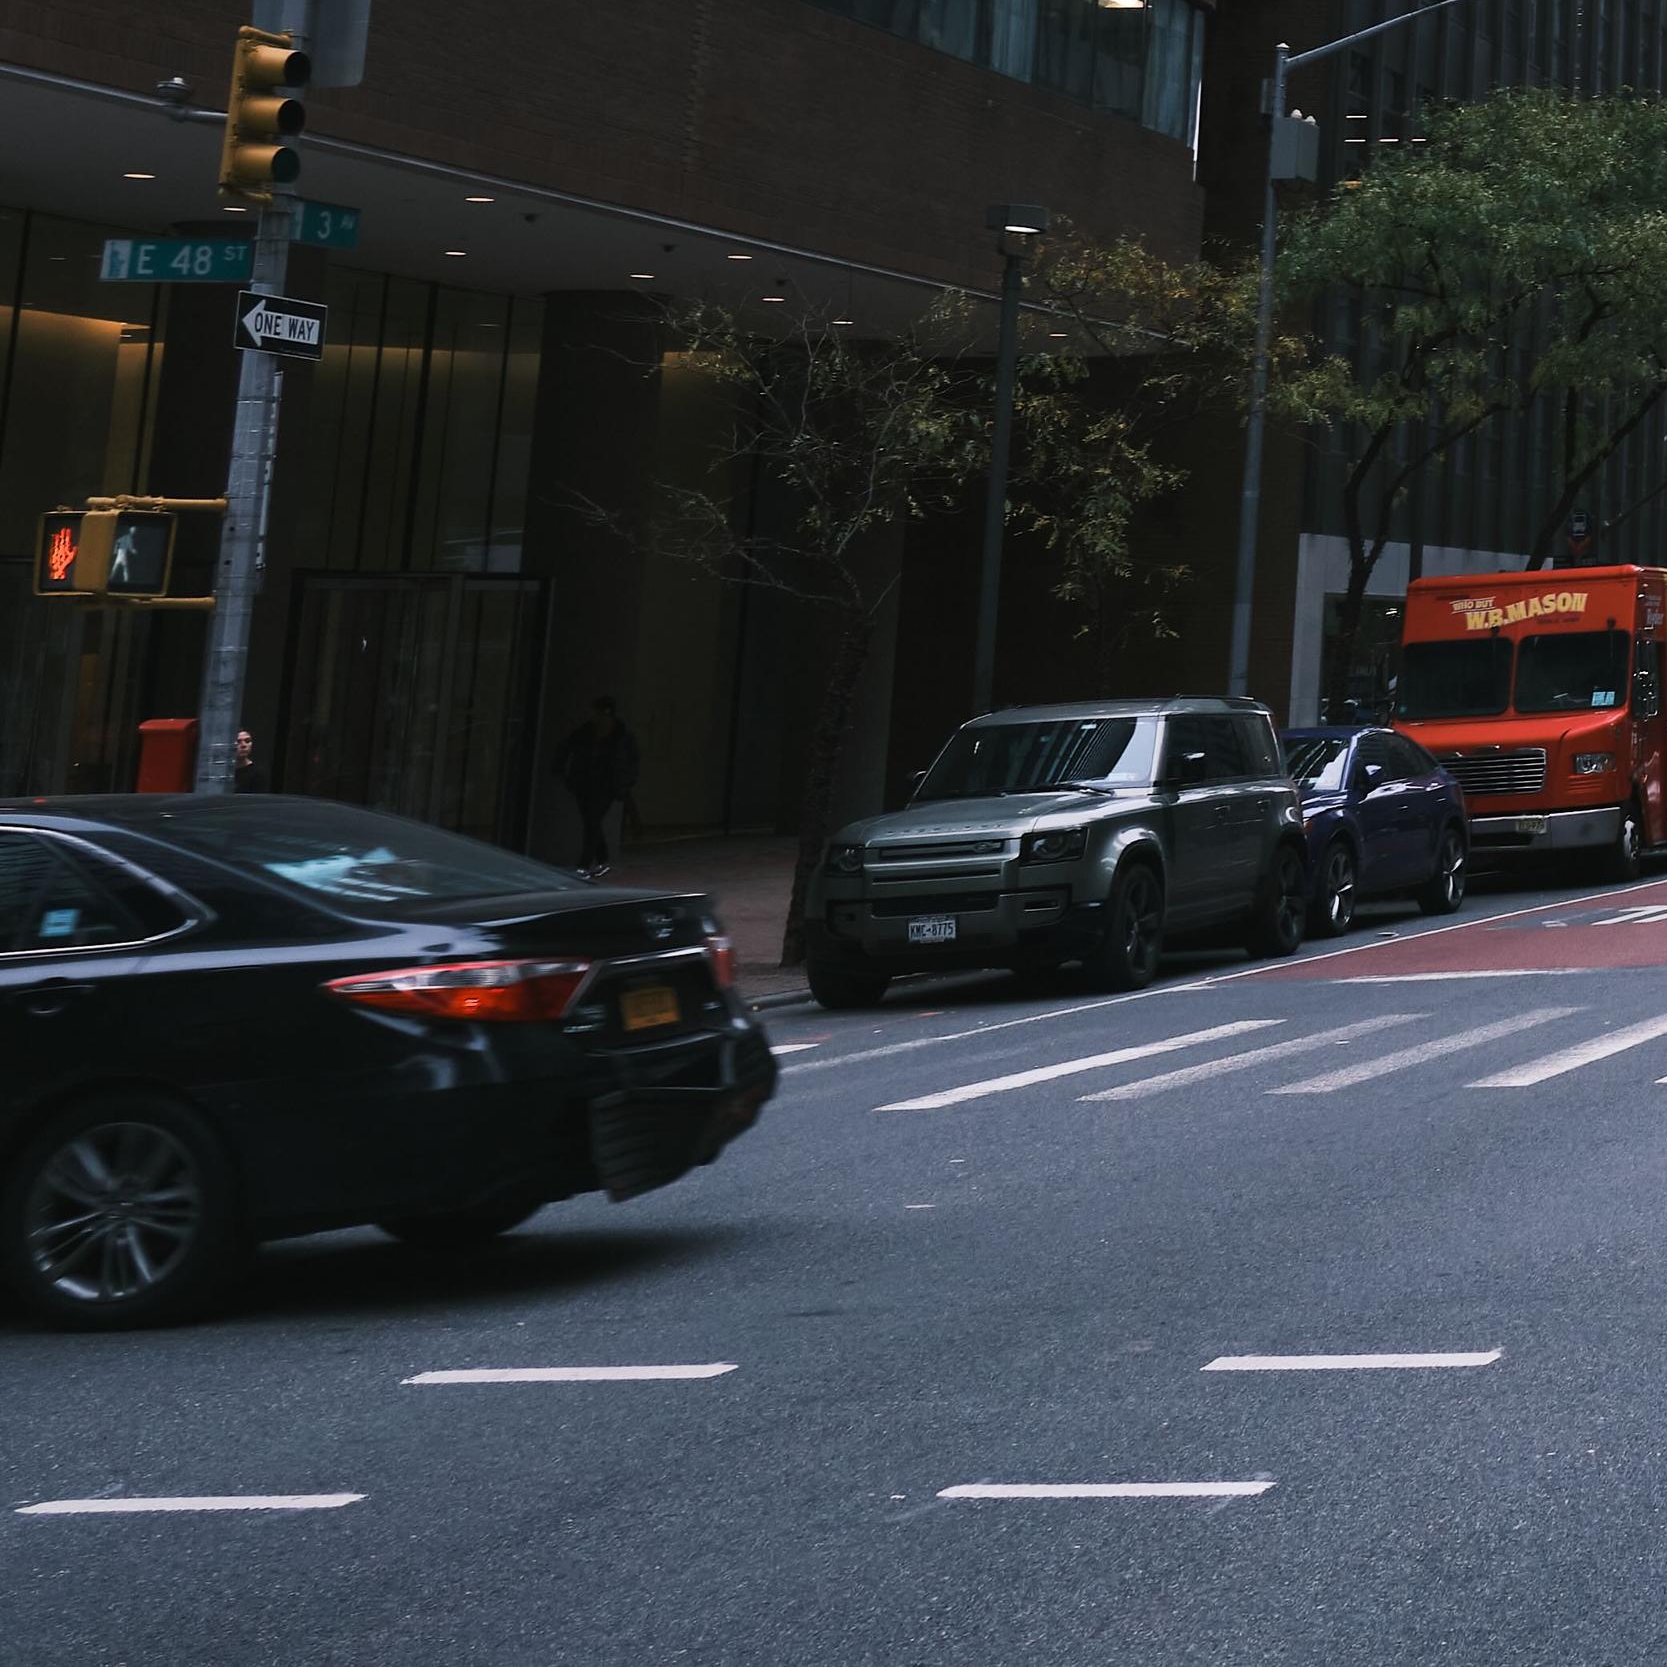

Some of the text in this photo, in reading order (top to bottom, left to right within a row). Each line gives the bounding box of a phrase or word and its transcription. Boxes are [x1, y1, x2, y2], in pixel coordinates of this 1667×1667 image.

[317, 210, 332, 240] 3
[136, 244, 249, 276] E 48 ST
[253, 311, 317, 342] ONE WAY
